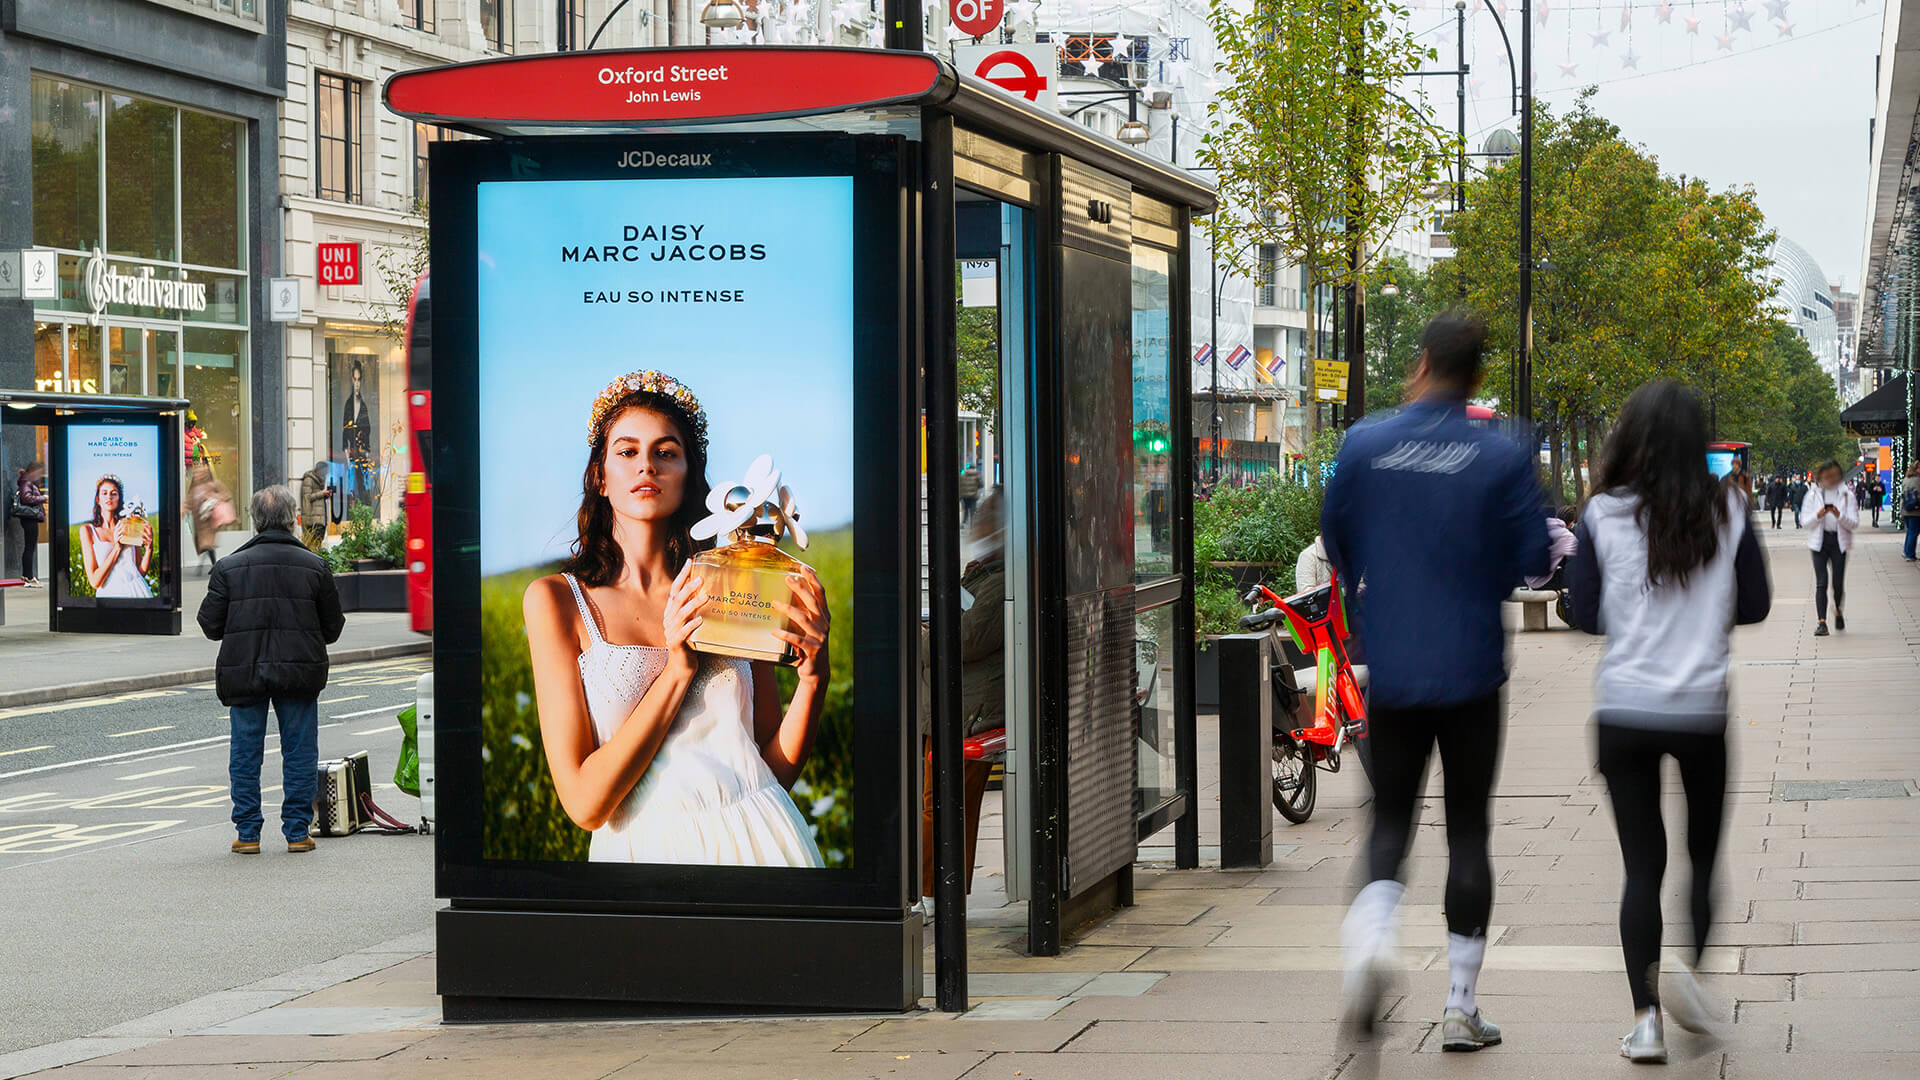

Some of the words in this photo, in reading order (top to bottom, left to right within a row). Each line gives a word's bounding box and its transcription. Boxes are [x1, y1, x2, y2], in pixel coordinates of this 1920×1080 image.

[956, 0, 993, 22] OF
[598, 66, 664, 84] Oxford
[670, 65, 728, 82] Street
[626, 91, 659, 103] John
[663, 89, 701, 102] Lewis
[617, 151, 712, 168] JCDecaux
[931, 181, 938, 191] 4
[623, 224, 705, 242] DAISY
[322, 248, 351, 263] UNI
[562, 246, 640, 262] MARC
[651, 244, 766, 261] JACOBS
[323, 265, 354, 283] QLO
[584, 291, 621, 304] EAU
[627, 291, 654, 303] SO
[660, 290, 744, 302] INTENSE
[708, 595, 735, 604] MARC
[738, 600, 774, 609] JACOB
[729, 591, 760, 600] DAISY
[740, 612, 772, 620] INTENSE
